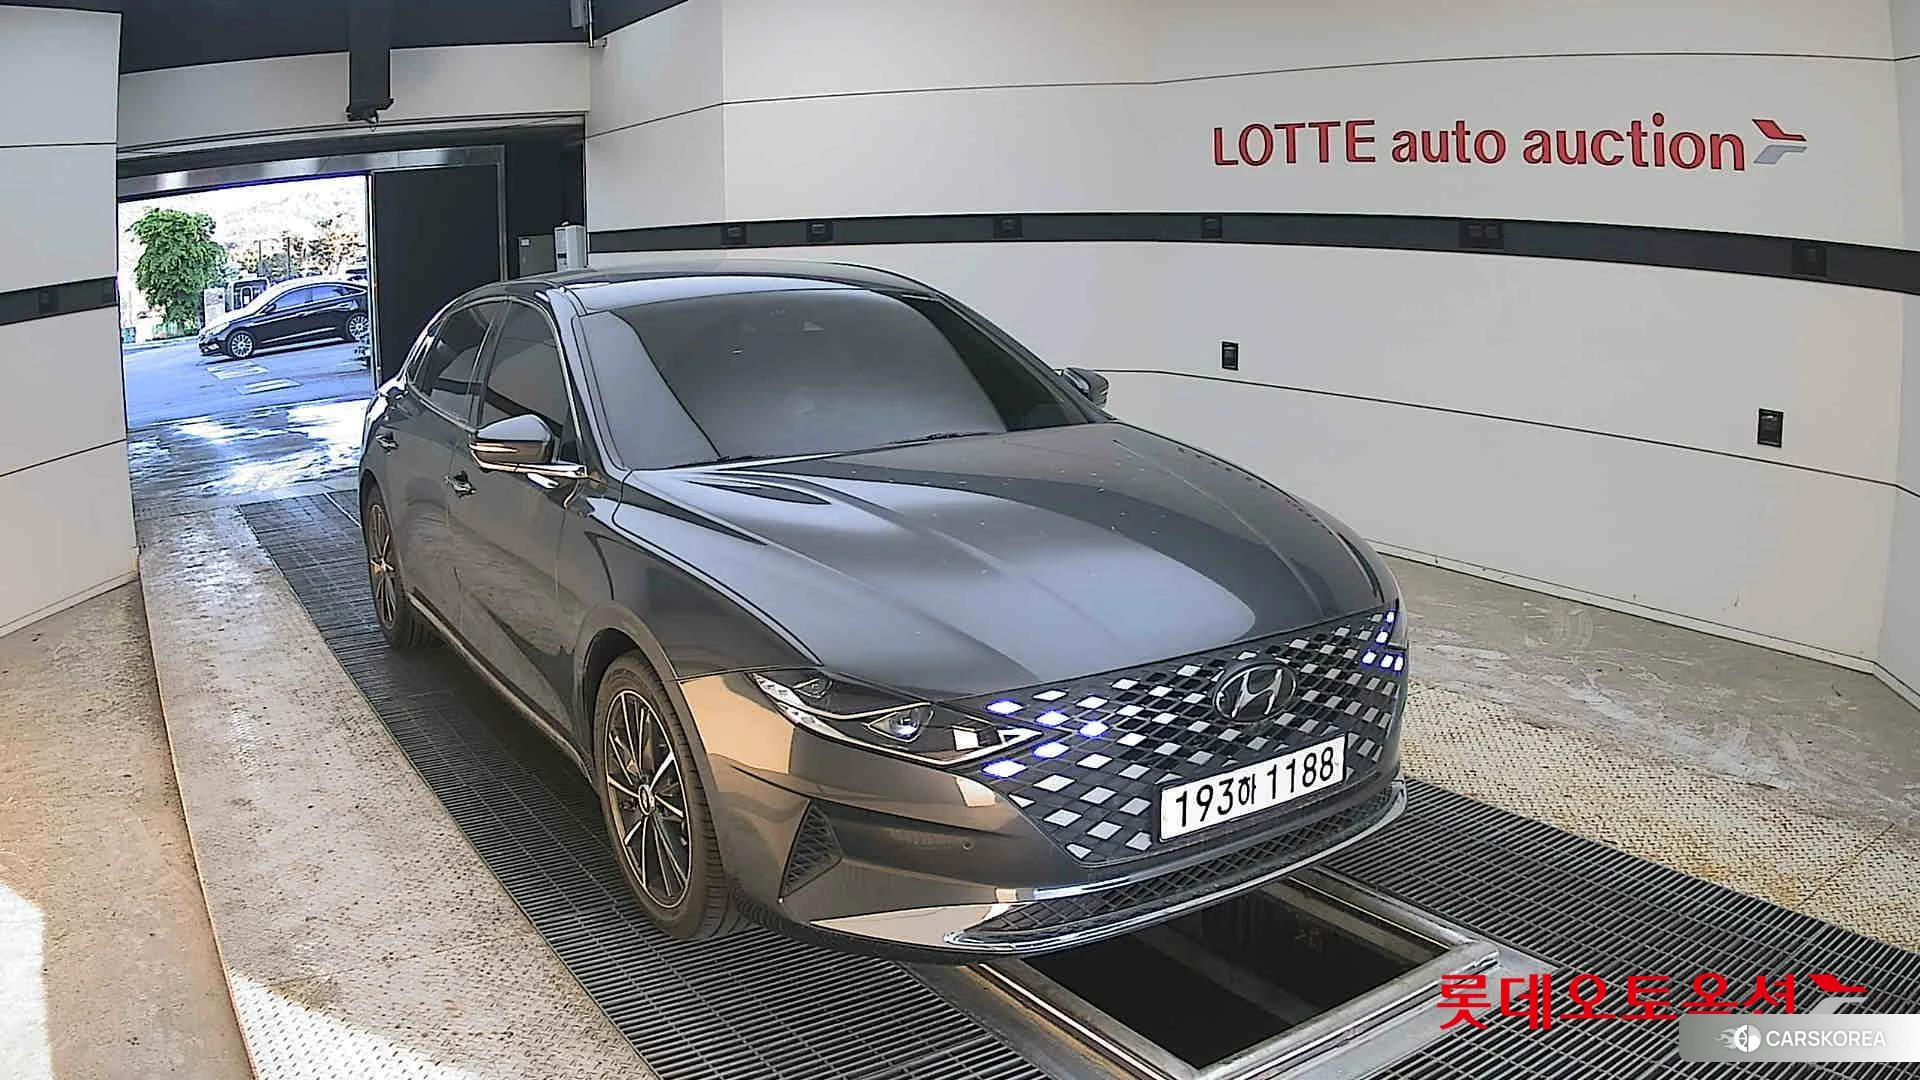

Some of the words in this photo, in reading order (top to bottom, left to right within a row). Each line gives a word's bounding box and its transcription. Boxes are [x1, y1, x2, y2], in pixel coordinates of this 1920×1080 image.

[1212, 118, 1377, 167] LOTTE
[1391, 119, 1508, 165] auto
[1522, 113, 1746, 171] auction
[1175, 773, 1257, 828] 193하
[1266, 746, 1334, 800] 1188
